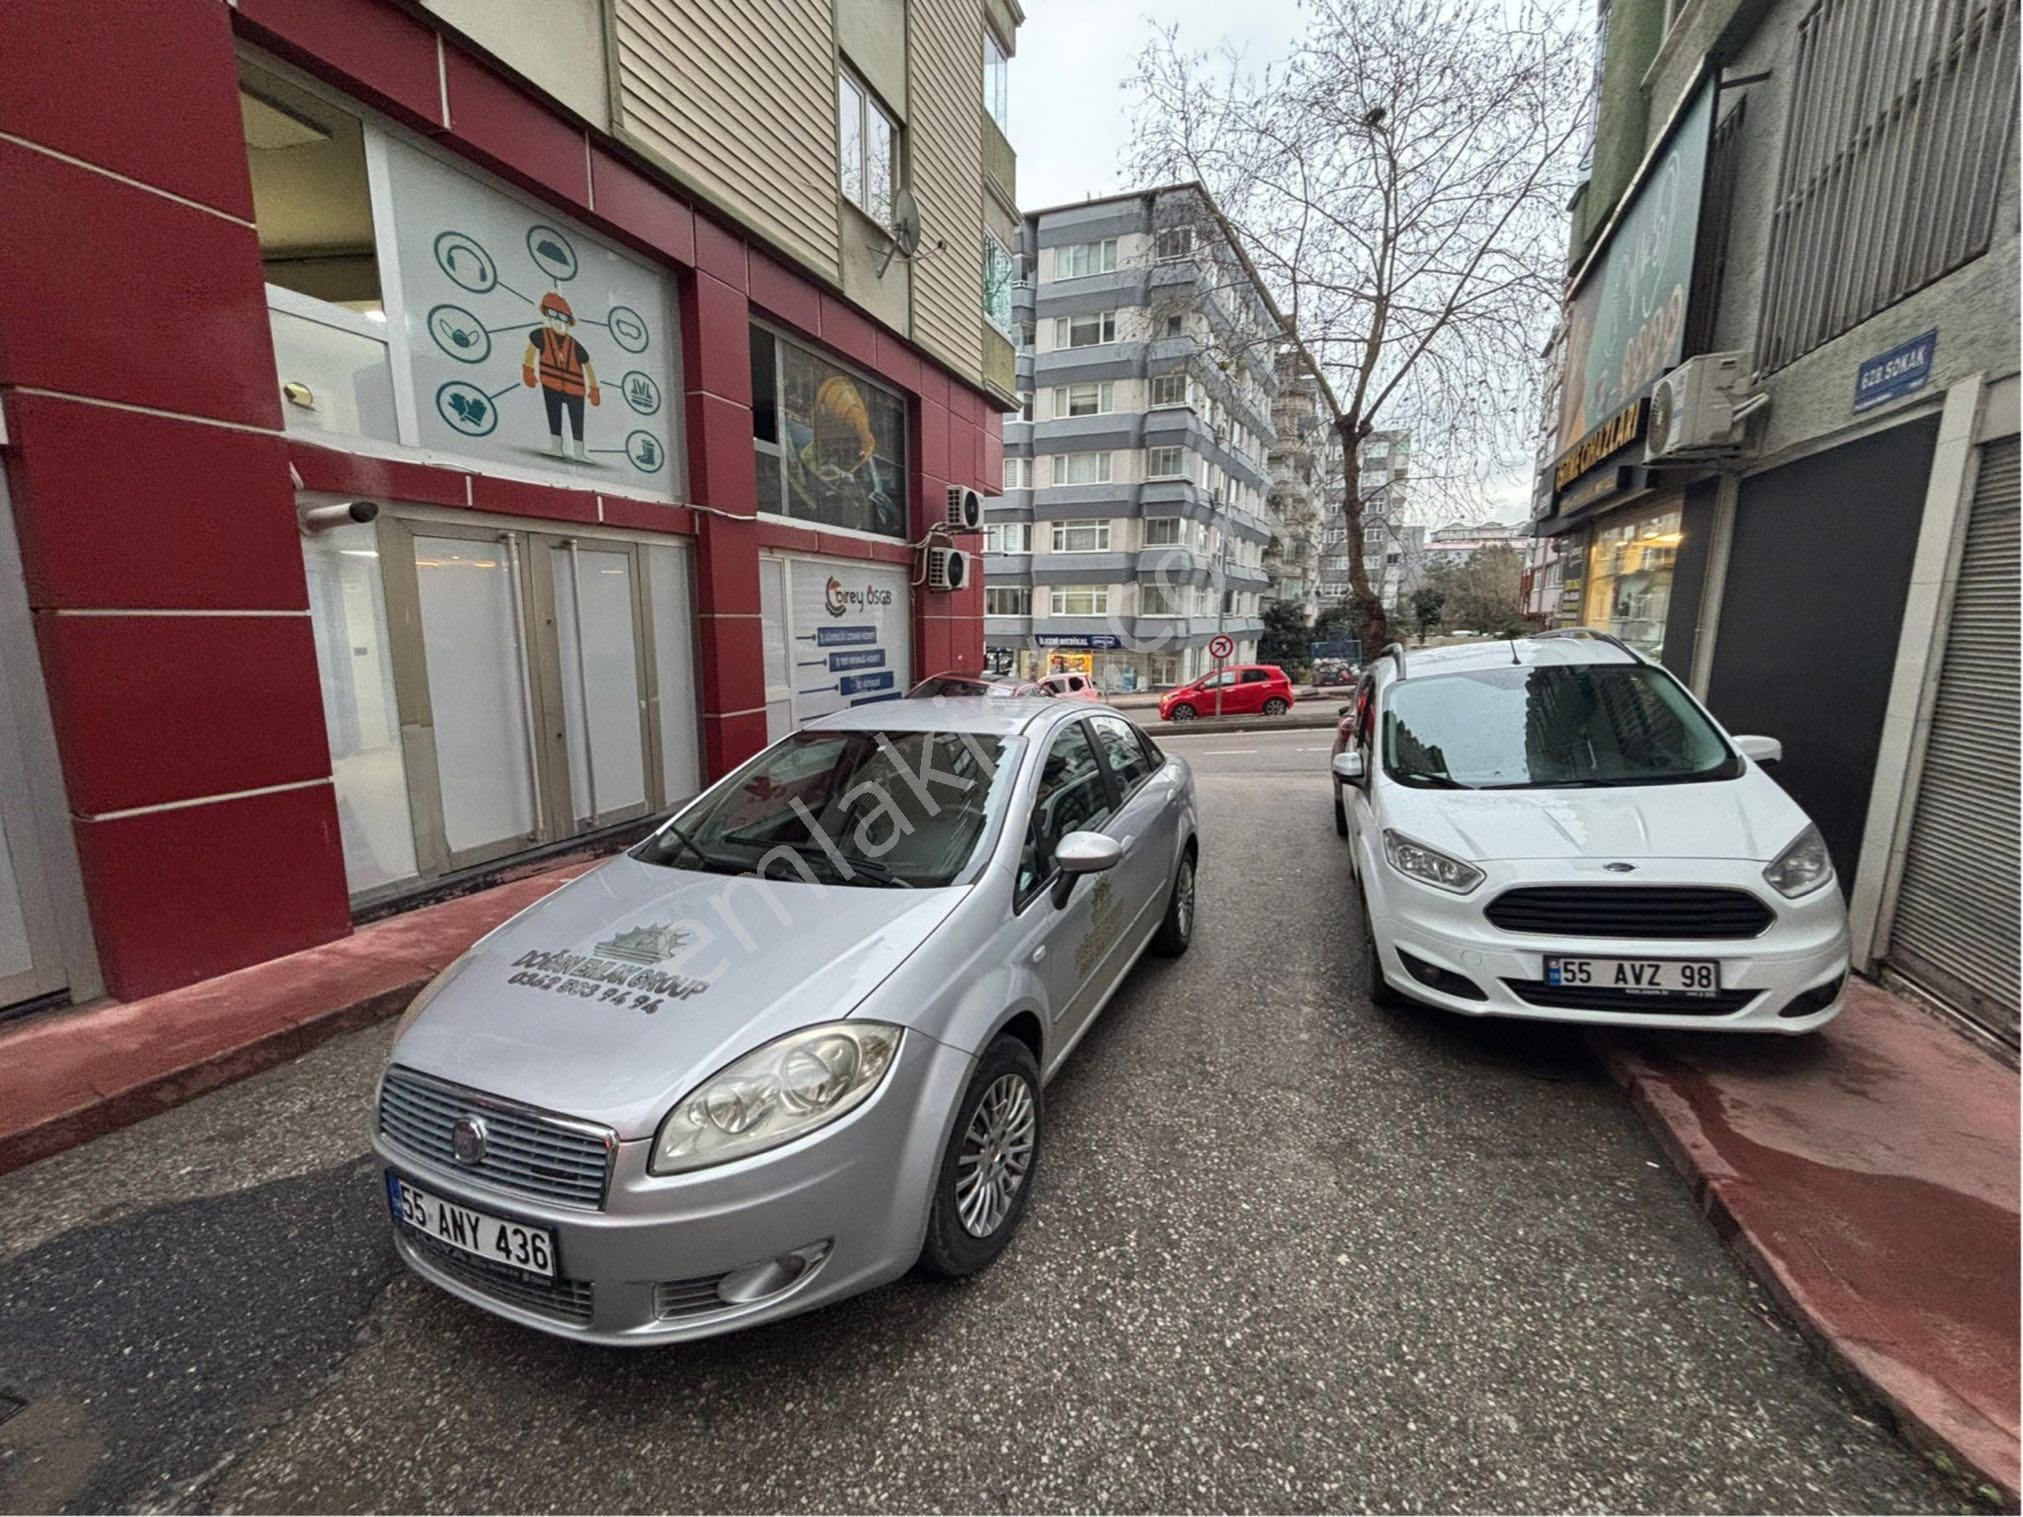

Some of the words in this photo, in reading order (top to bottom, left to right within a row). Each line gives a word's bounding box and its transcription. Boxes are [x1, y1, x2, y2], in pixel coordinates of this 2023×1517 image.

[1885, 346, 1926, 380] SOKAK
[627, 968, 711, 1001] GROUP
[1563, 961, 1592, 984] 55
[1614, 963, 1662, 986] AVZ
[1681, 965, 1712, 989] 98
[400, 1184, 427, 1226] 55
[439, 1203, 480, 1250] ANY
[496, 1224, 549, 1270] 436
